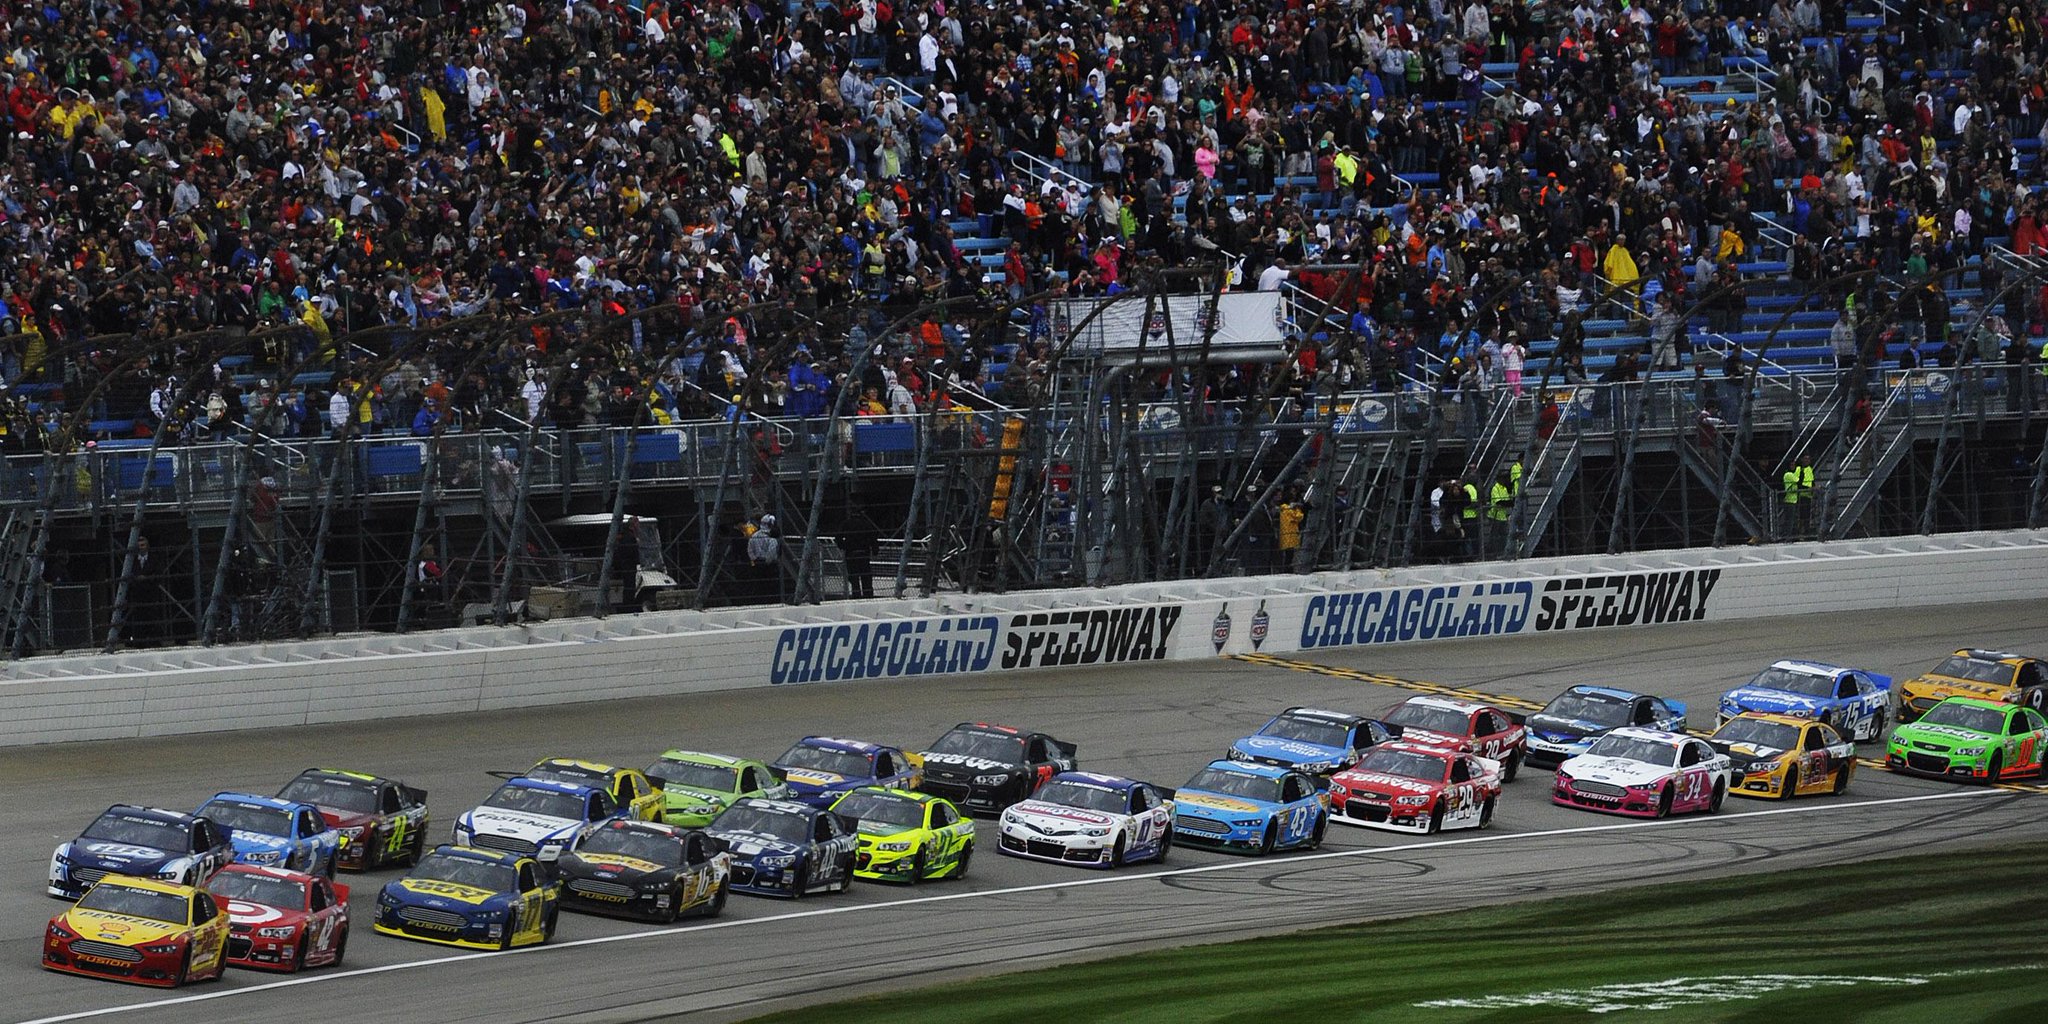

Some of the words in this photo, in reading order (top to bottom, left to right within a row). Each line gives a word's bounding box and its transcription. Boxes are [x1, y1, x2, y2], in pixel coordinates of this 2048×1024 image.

[1300, 581, 1533, 649] CHICAGOLAND
[1535, 569, 1721, 631] SPEEDWAY
[770, 616, 1000, 685] CHICAGOLAND
[1001, 606, 1182, 669] SPEEDWAY
[2033, 689, 2043, 710] 9
[1844, 702, 1860, 730] 15
[2015, 737, 2035, 768] 10
[788, 769, 833, 781] NAPA
[1061, 780, 1115, 793] ALLMENDINGER
[1684, 773, 1703, 802] 34
[1576, 791, 1620, 803] FUSION
[1022, 804, 1105, 822] KINGSFORD
[1458, 785, 1474, 830] 29
[475, 812, 558, 831] FASTENAL
[1291, 807, 1308, 837] 43
[1029, 836, 1065, 845] CAMRY
[125, 887, 158, 897] LOGANO
[692, 866, 710, 902] 16
[577, 891, 628, 904] FUSION
[79, 911, 171, 930] PENNZOIL
[407, 920, 458, 933] FUSION
[317, 915, 334, 951] 42
[77, 954, 132, 968] FUSION
